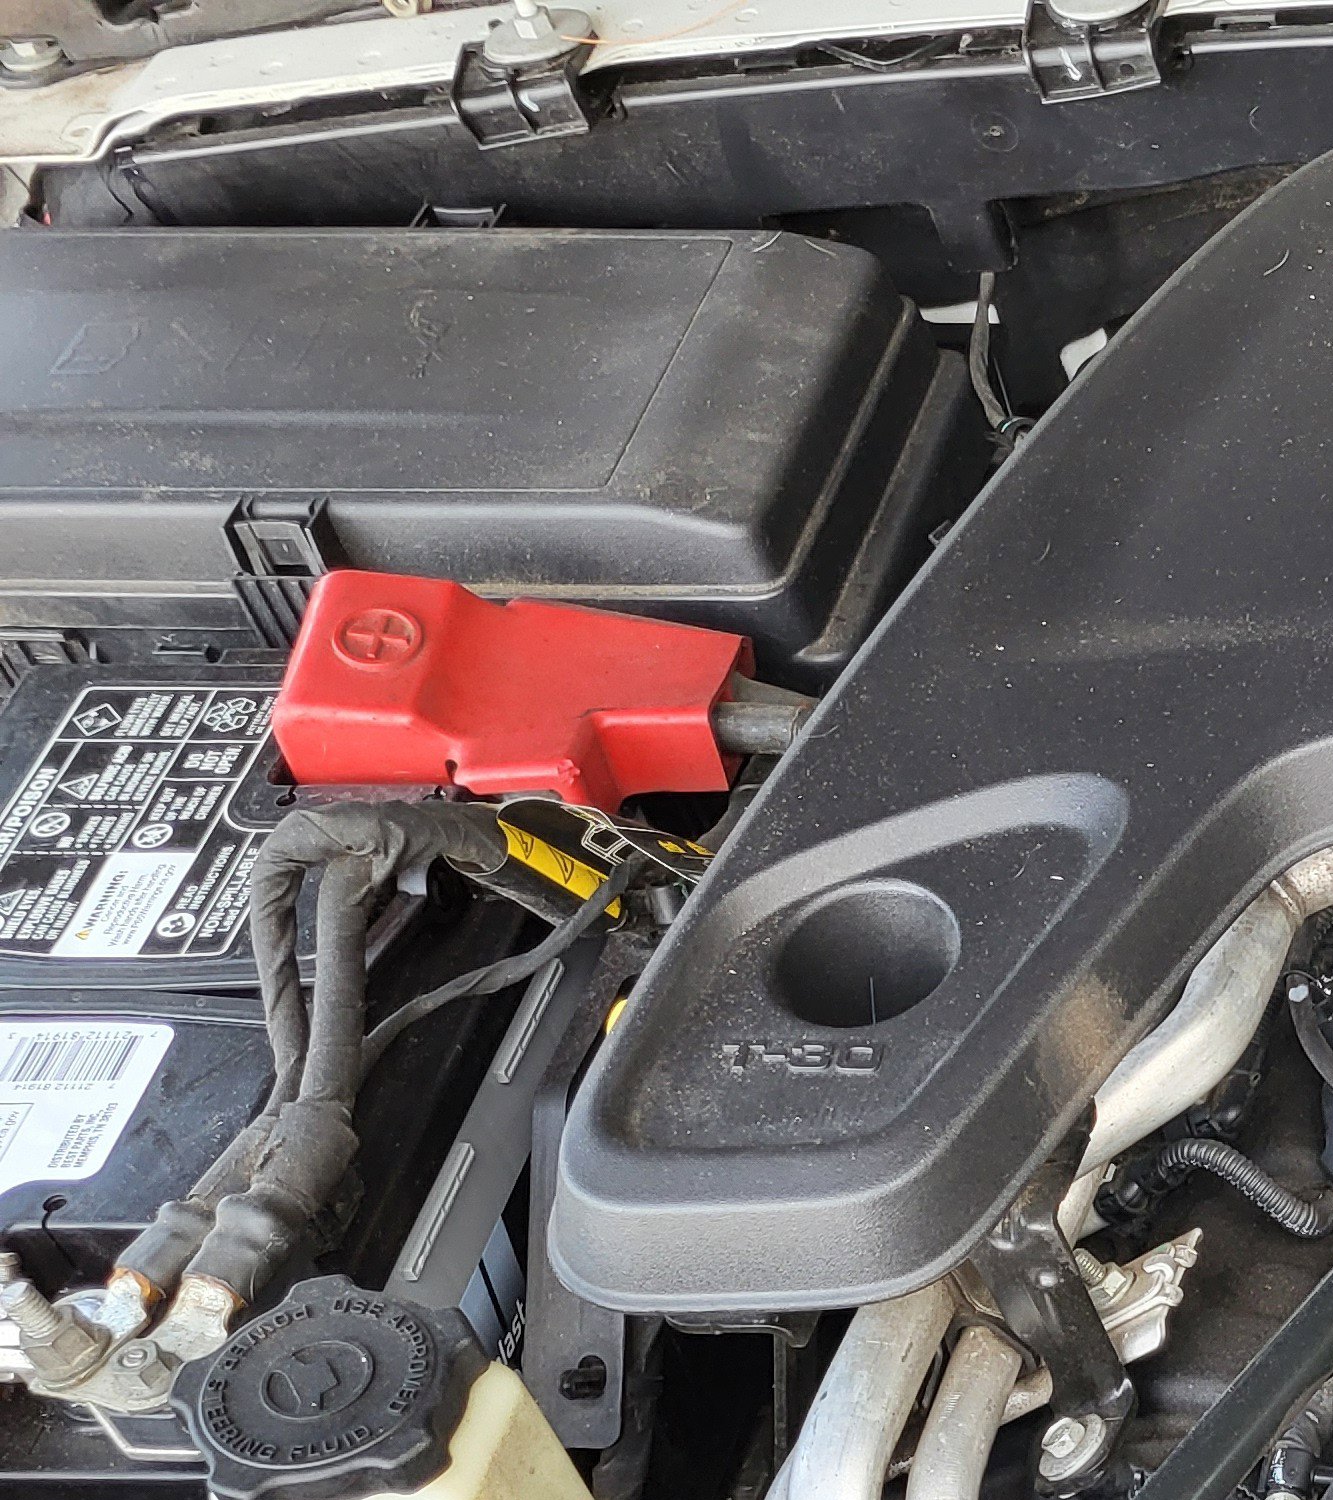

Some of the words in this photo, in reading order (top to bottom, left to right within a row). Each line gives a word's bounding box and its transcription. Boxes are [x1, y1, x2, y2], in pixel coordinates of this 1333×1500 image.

[111, 763, 137, 784] CAUSE
[180, 753, 205, 768] DO
[197, 749, 224, 770] NOT
[102, 786, 123, 800] CAN
[115, 763, 151, 800] BLINDNESS
[30, 924, 50, 939] CAN
[40, 900, 65, 923] CAUSE
[56, 859, 91, 898] BLINDNESS
[174, 885, 199, 909] READ
[199, 847, 260, 938] NON-SPILLABLE
[14, 896, 54, 938] EXPLOSIVE
[44, 929, 62, 939] OR
[216, 909, 240, 931] Lead
[85, 1031, 133, 1041] 21112
[721, 1041, 885, 1076] T-30
[46, 1125, 80, 1167] DISTRIBUTED
[72, 1114, 86, 1122] BY
[73, 1133, 102, 1167] MEMPHIS,
[92, 1124, 106, 1132] TN
[60, 1151, 78, 1167] BEST
[223, 1304, 313, 1370] POWER
[496, 1299, 526, 1366] last
[333, 1298, 386, 1318] USE
[388, 1314, 428, 1416] APPROVED
[208, 1379, 277, 1460] STEERING
